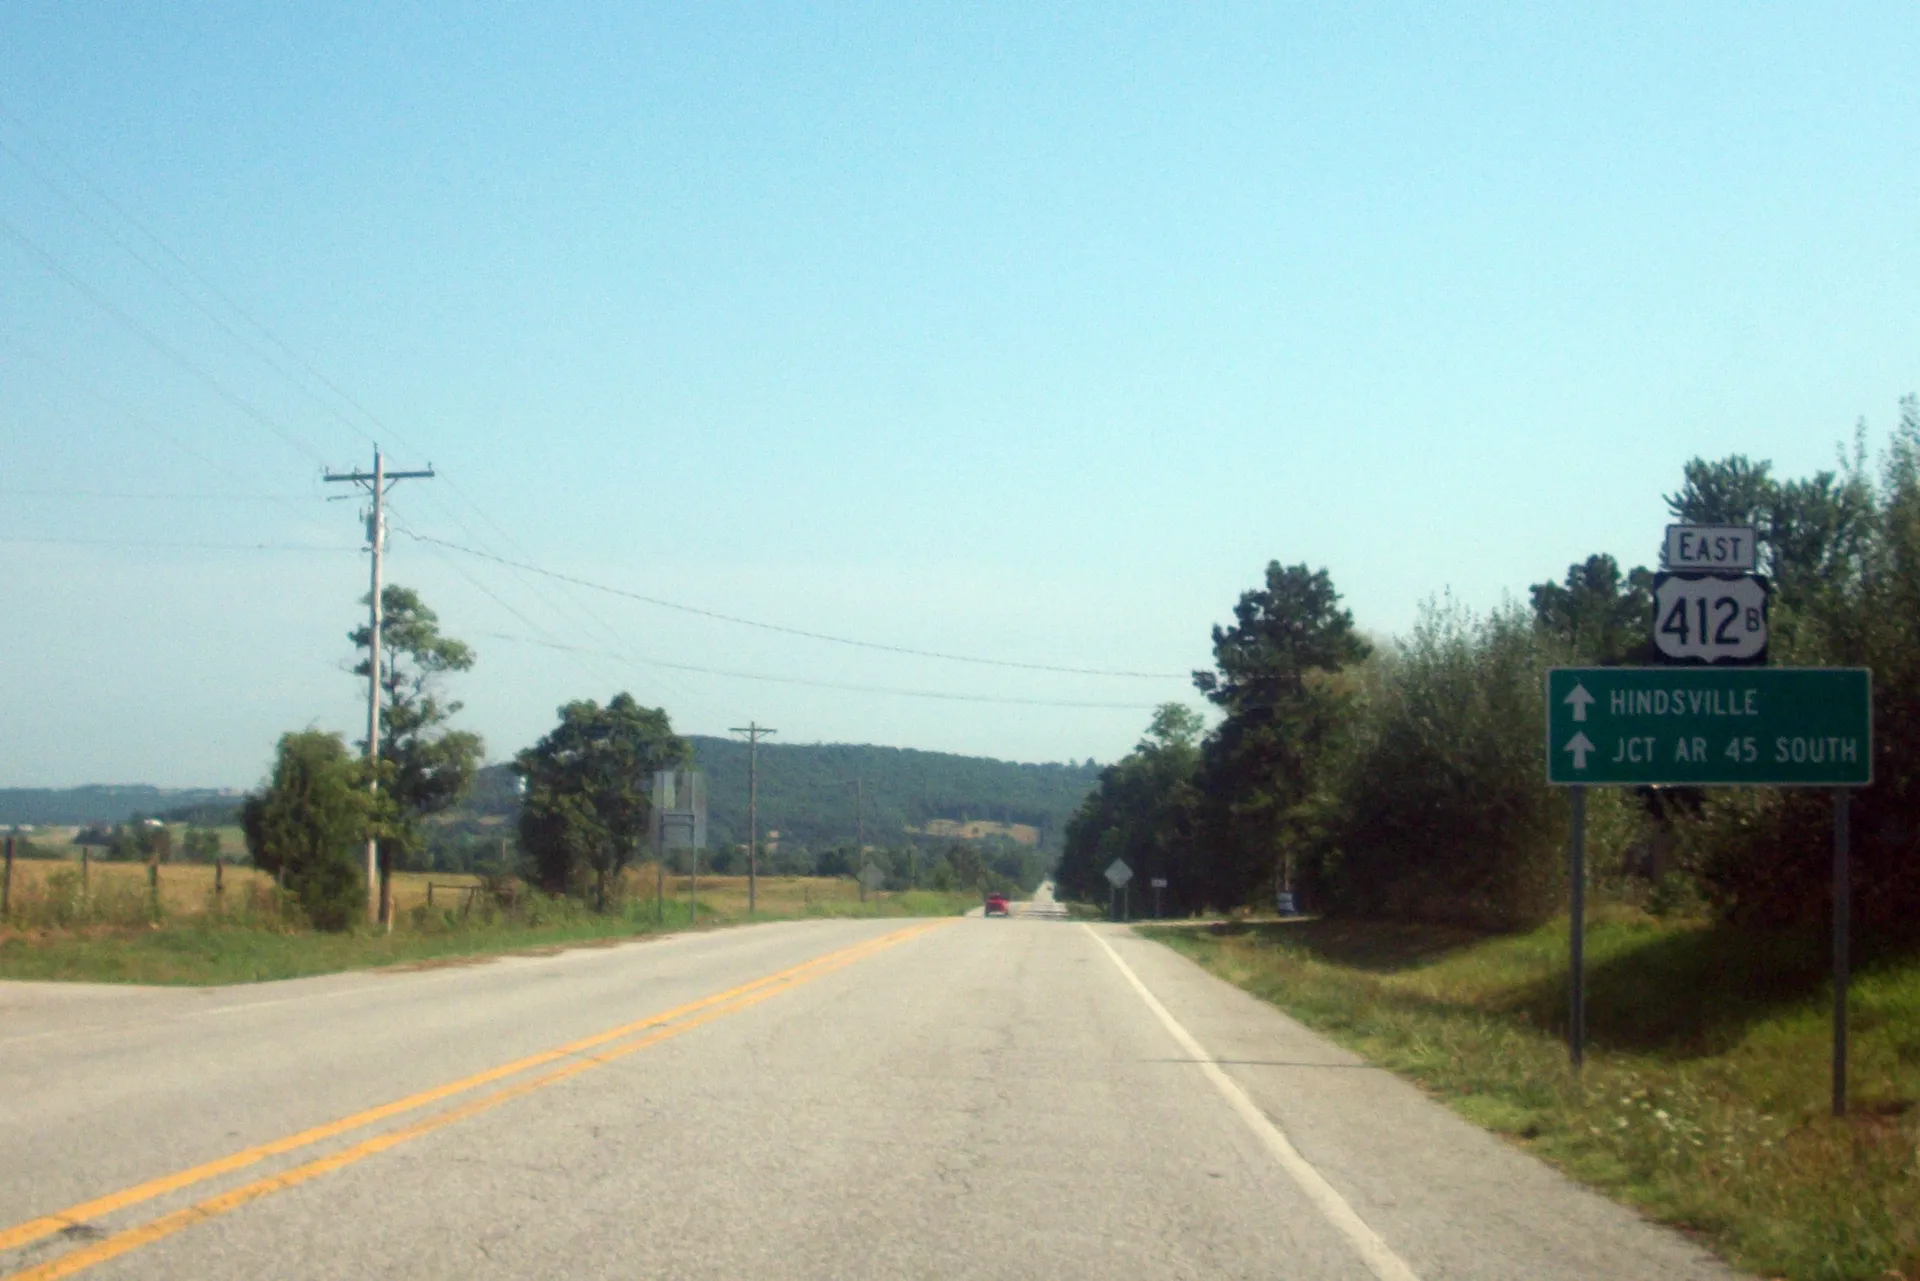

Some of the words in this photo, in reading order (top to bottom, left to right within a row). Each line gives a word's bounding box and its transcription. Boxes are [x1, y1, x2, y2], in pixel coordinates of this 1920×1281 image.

[1679, 531, 1742, 562] EAST
[1609, 689, 1759, 716] HINDSVILLE
[1612, 737, 1656, 763] JCT
[1674, 737, 1708, 763] AR
[1724, 737, 1757, 763] 45
[1775, 736, 1858, 763] SOUTH
